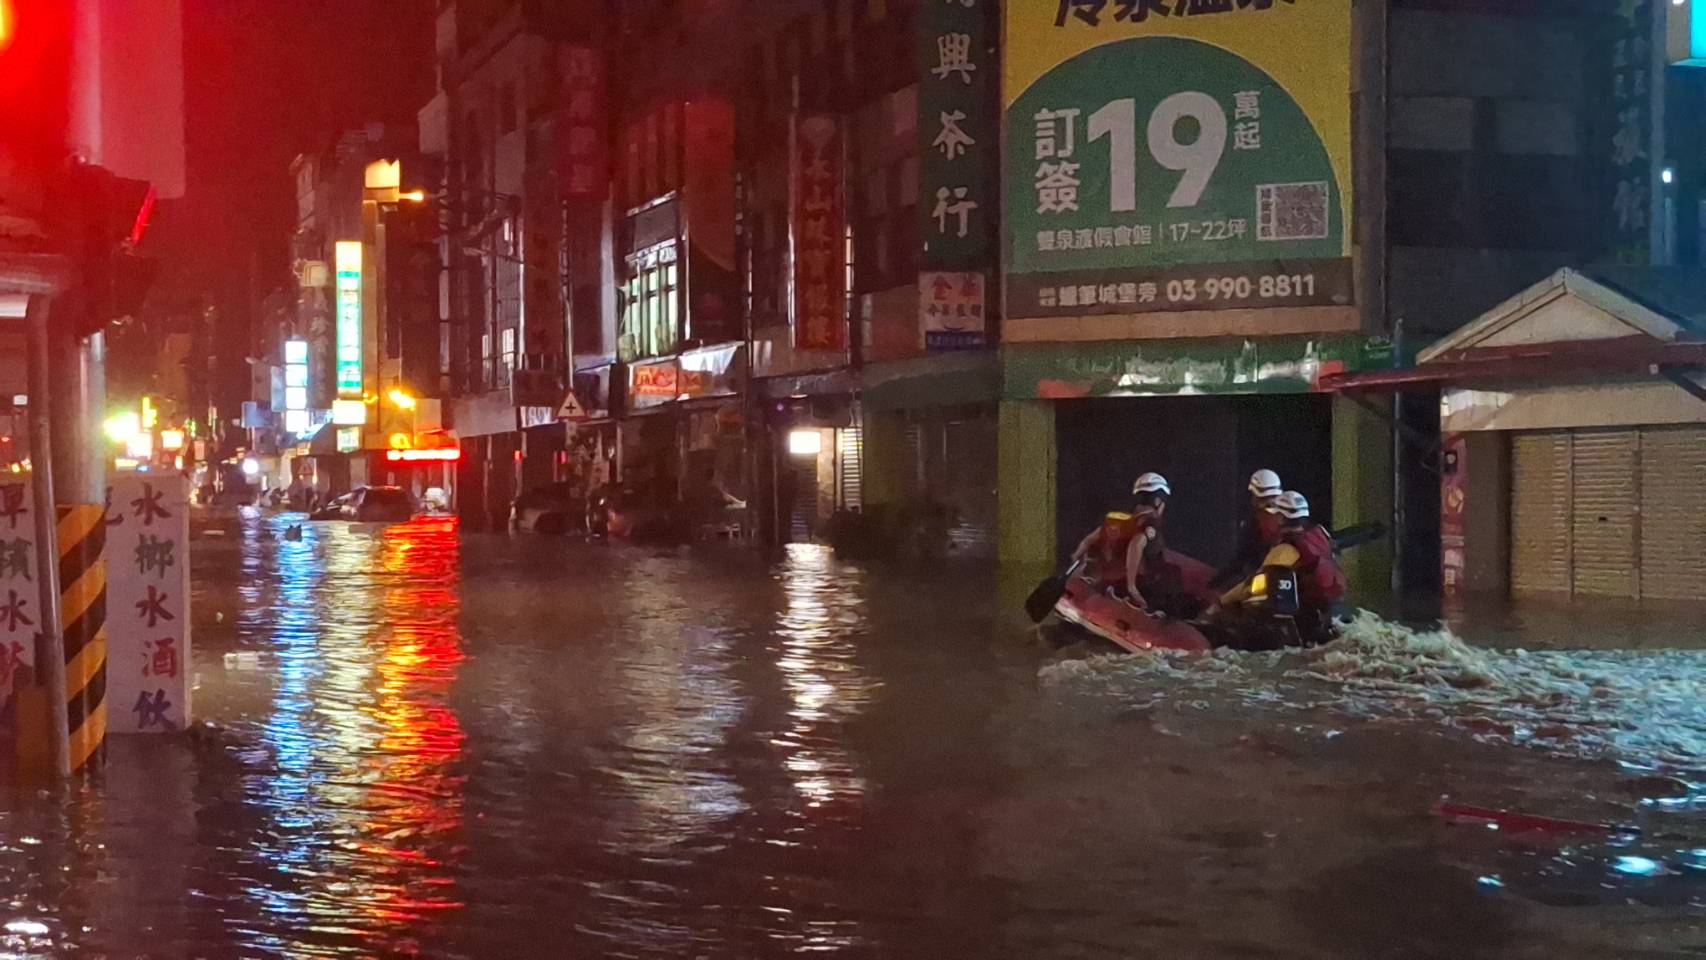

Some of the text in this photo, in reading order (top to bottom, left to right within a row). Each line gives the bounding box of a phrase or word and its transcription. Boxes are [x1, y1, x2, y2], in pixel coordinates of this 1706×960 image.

[1233, 90, 1261, 150] 萬起
[1034, 107, 1080, 214] 訂簽
[1087, 90, 1228, 212] 19
[1166, 279, 1198, 302] 03
[1207, 277, 1251, 300] 990
[1258, 275, 1316, 299] 8811
[1279, 580, 1292, 590] 30
